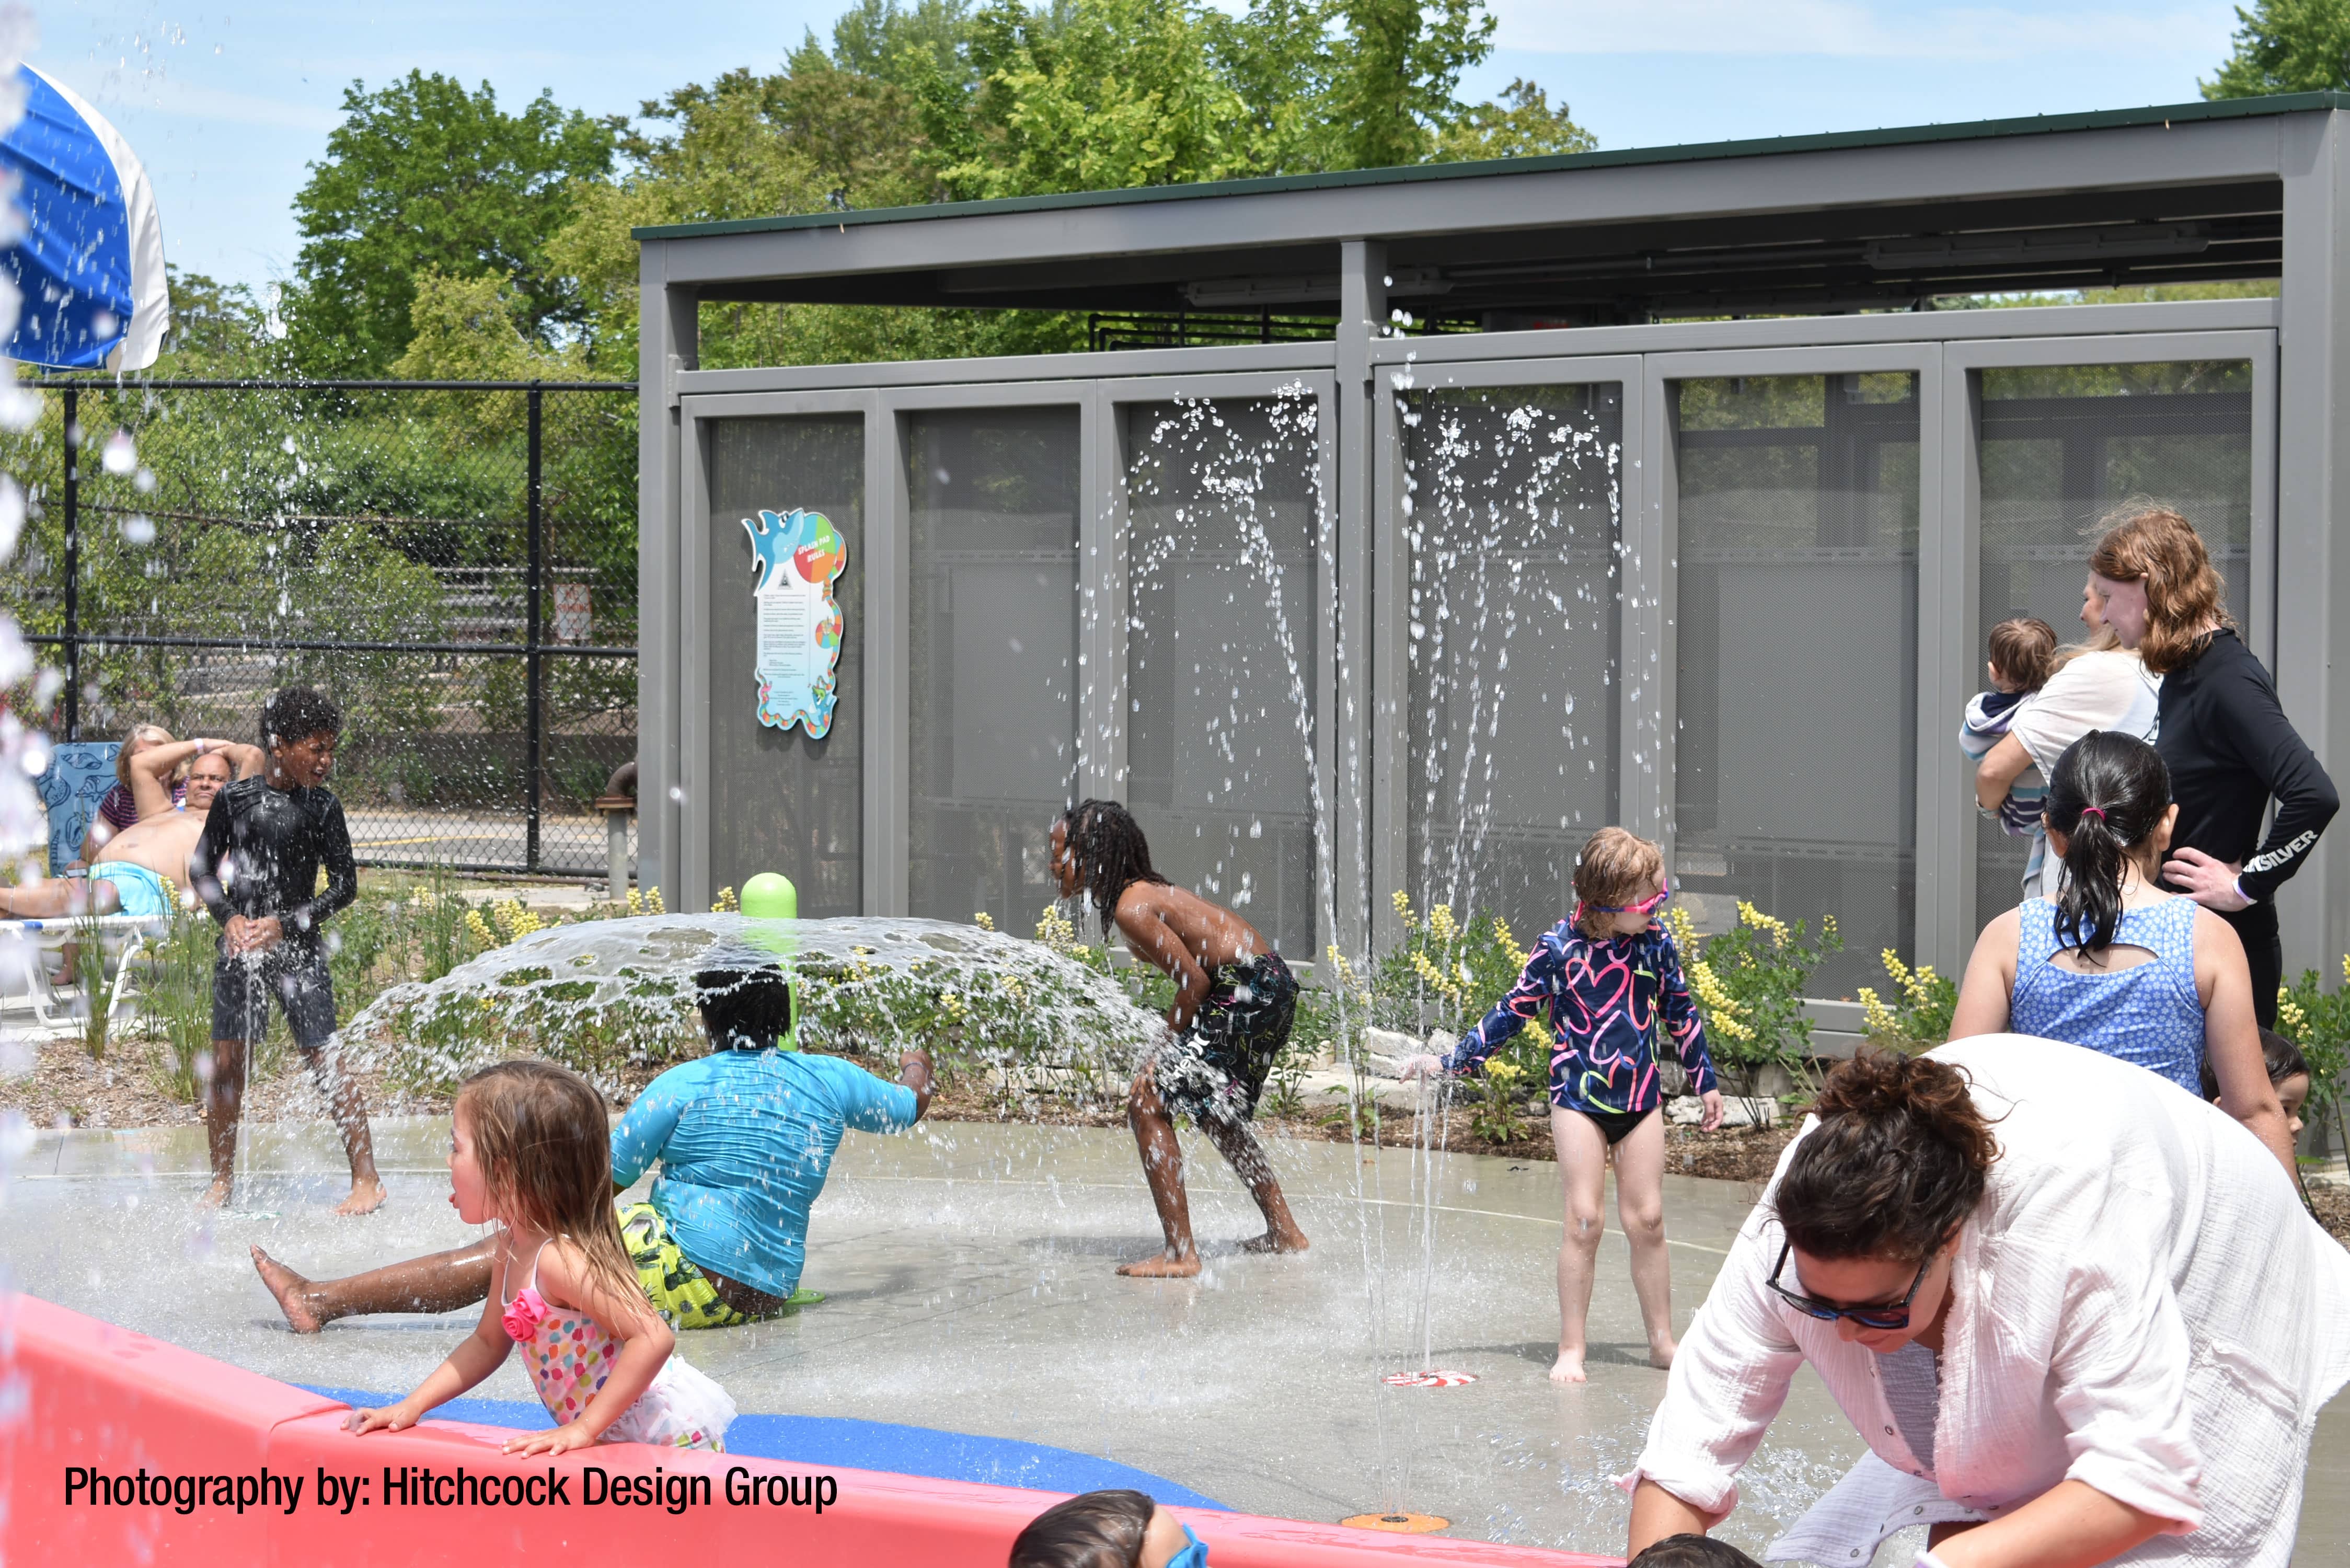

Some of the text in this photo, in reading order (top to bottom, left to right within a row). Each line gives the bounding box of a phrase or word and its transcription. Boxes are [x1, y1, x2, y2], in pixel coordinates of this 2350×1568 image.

[798, 535, 830, 555] SPLASH PAD
[807, 549, 825, 563] RULES
